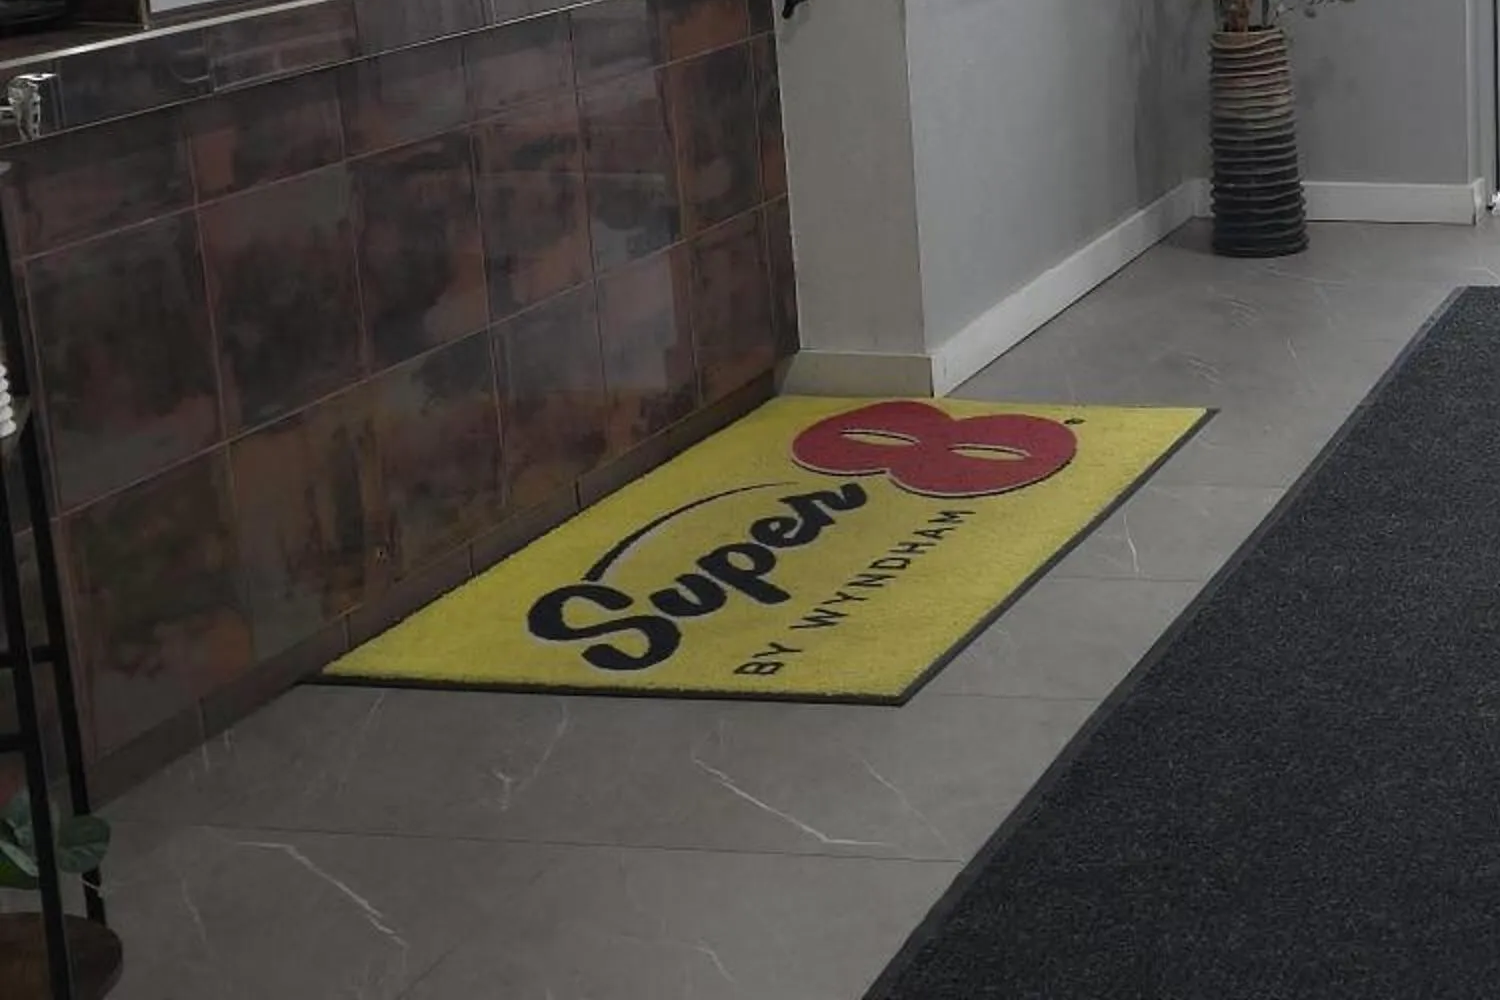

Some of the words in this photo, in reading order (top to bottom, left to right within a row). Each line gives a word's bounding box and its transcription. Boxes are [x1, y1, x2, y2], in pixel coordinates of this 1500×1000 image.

[527, 482, 868, 671] Super
[792, 400, 1078, 499] 8
[733, 640, 804, 678] BY
[791, 508, 977, 631] WYNDHAM
